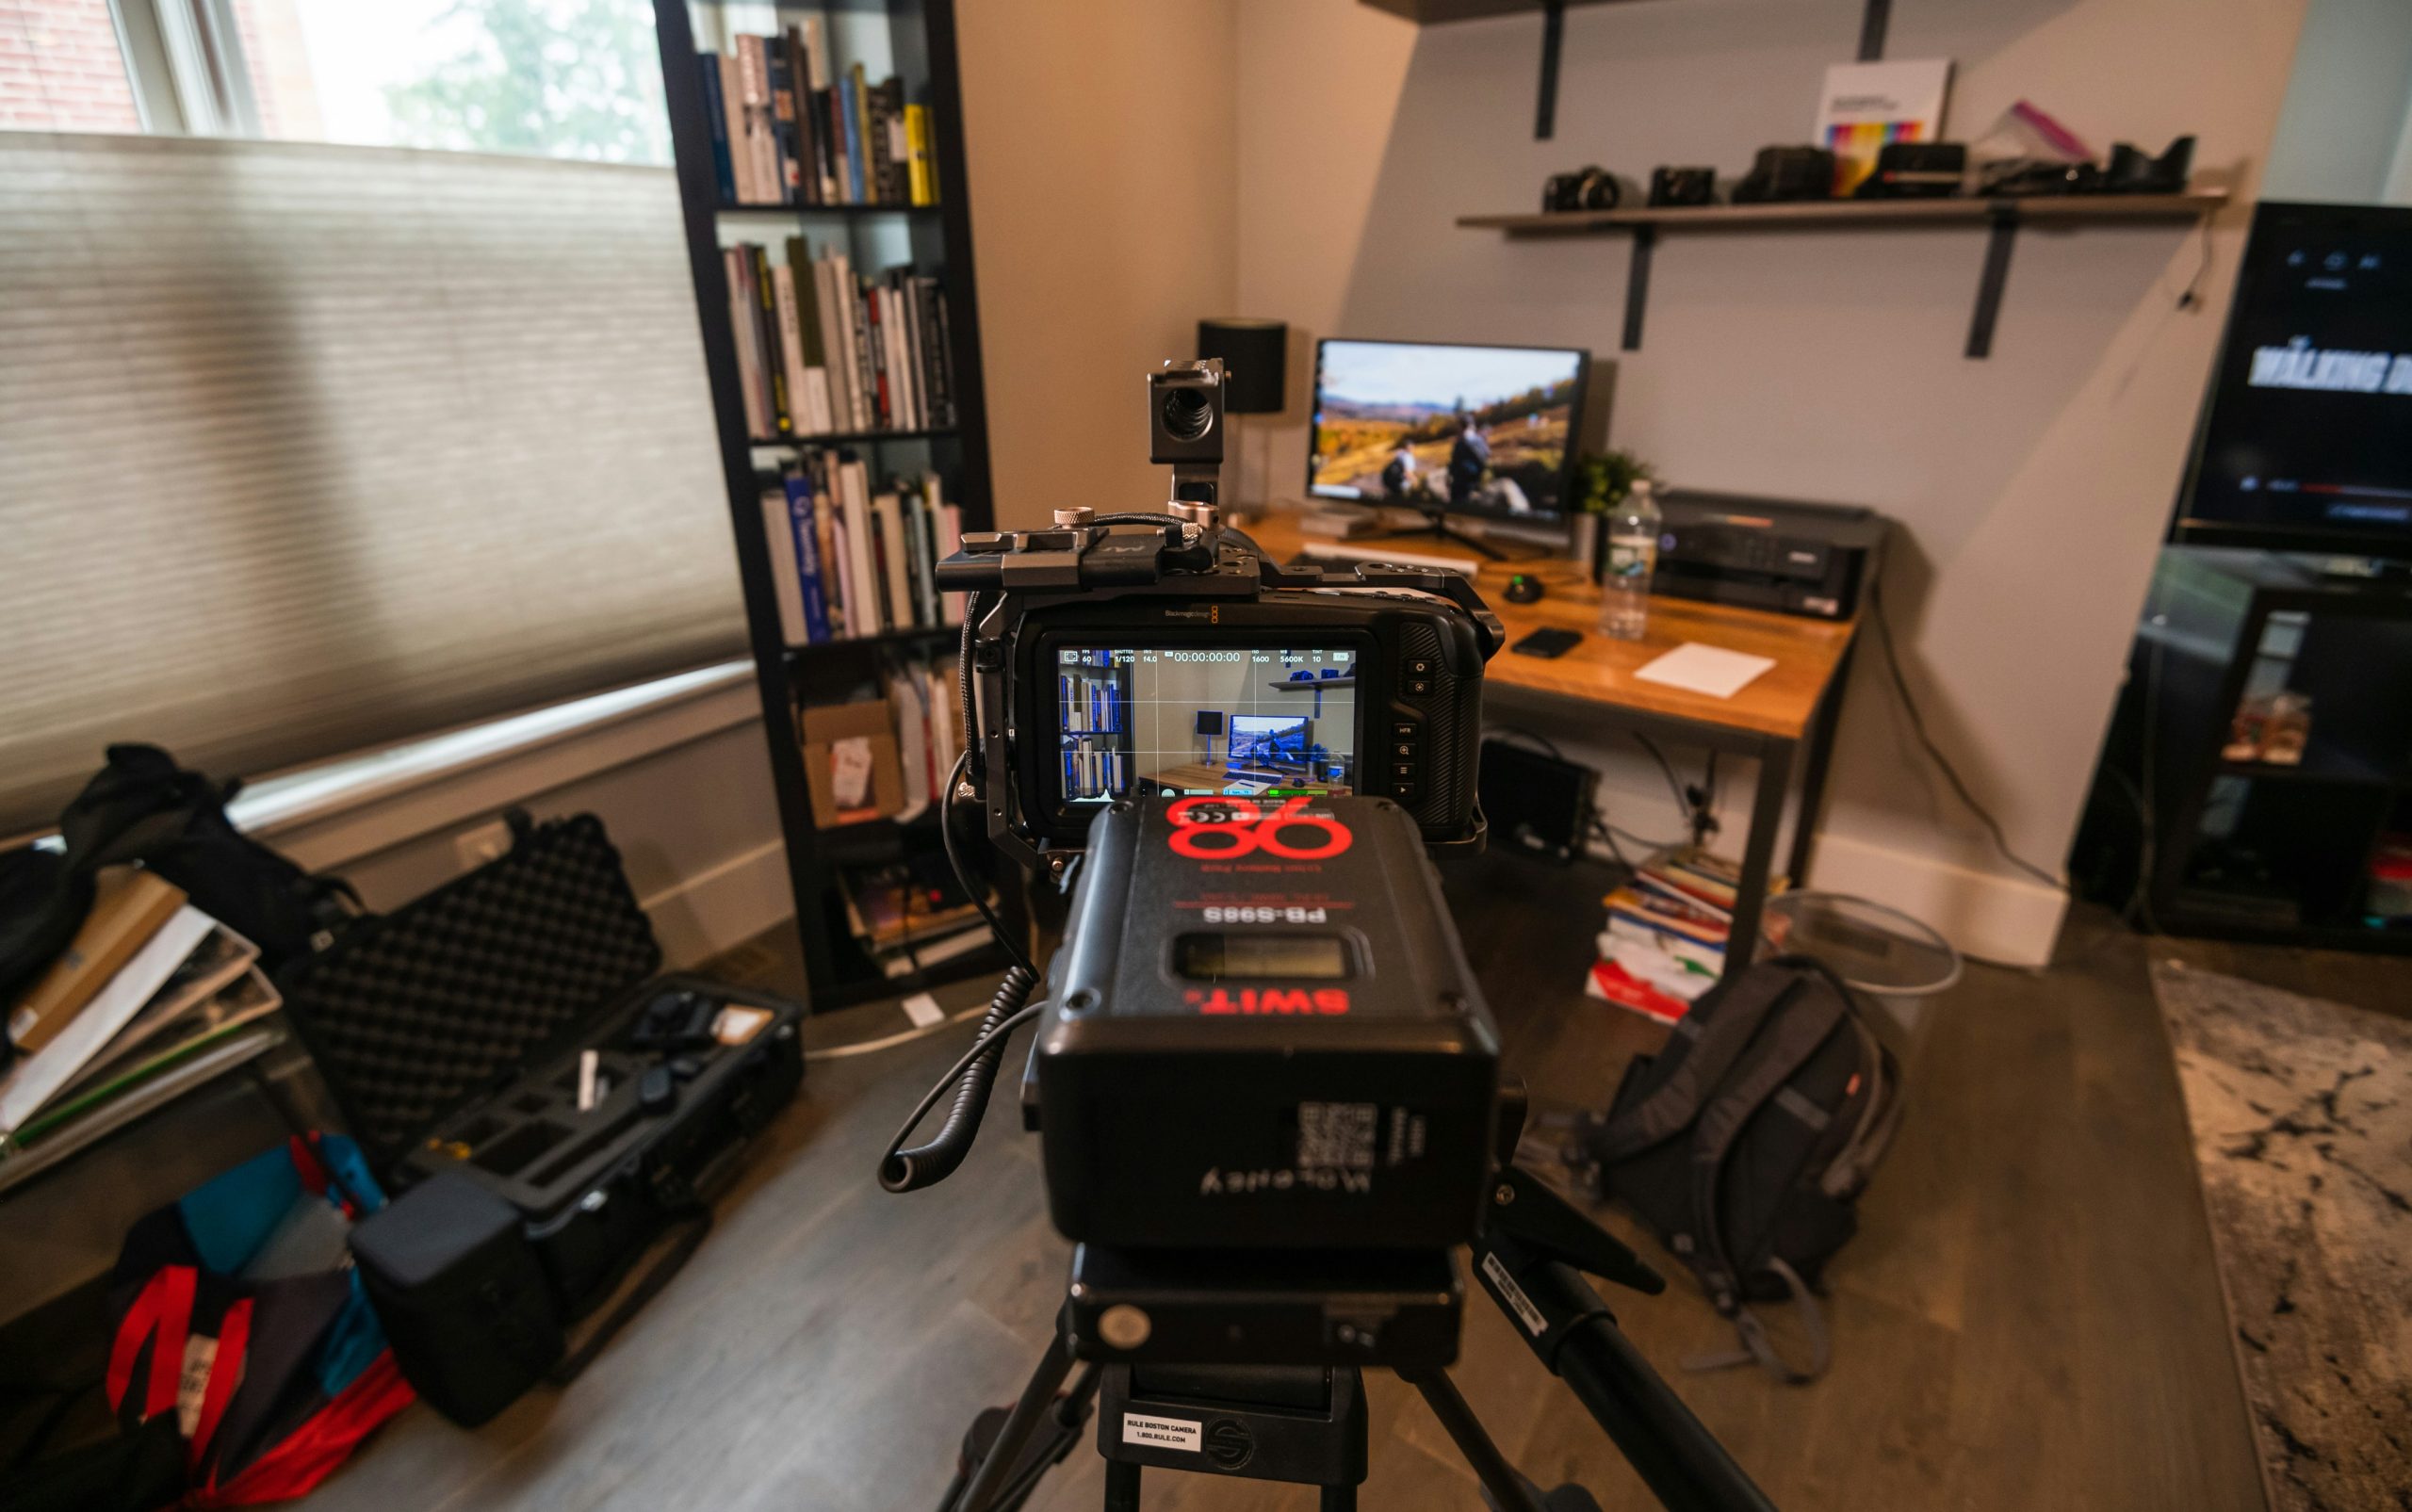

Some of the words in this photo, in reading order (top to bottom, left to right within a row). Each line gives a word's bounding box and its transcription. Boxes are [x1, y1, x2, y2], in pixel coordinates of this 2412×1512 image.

[1174, 652, 1240, 662] 00:00:00:00
[1165, 796, 1353, 859] 98
[1199, 989, 1348, 1015] SWIT
[1127, 1420, 1144, 1428] RULE
[1144, 1422, 1169, 1431] BOSTON
[1170, 1425, 1197, 1434] CAMERA
[1136, 1431, 1186, 1443] 1.800.RULE.COM
